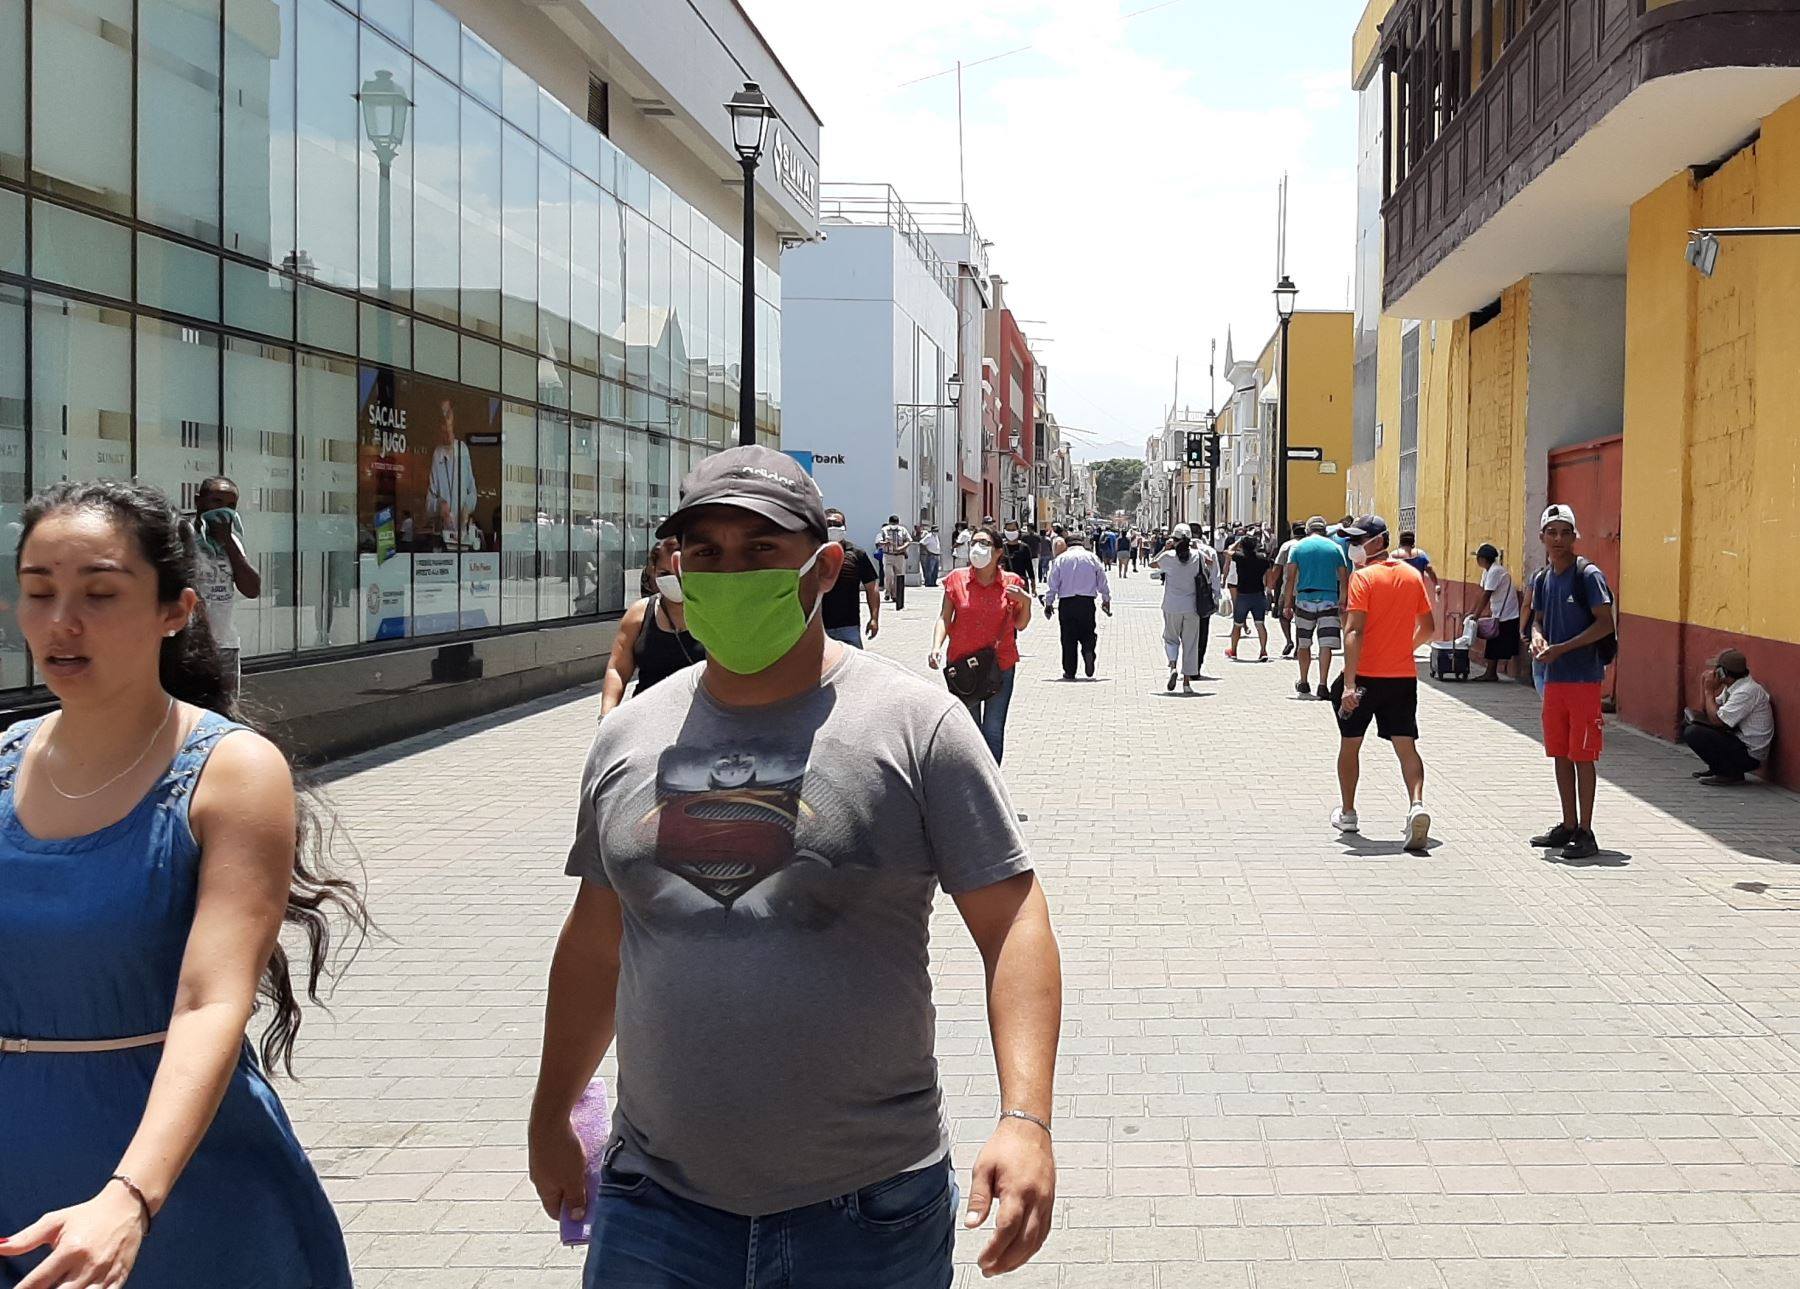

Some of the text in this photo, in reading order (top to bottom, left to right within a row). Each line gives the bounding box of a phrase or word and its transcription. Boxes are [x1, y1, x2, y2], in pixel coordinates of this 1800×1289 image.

[782, 143, 815, 202] SUNAT
[368, 400, 407, 430] SÁCALE
[380, 431, 407, 458] JUGO
